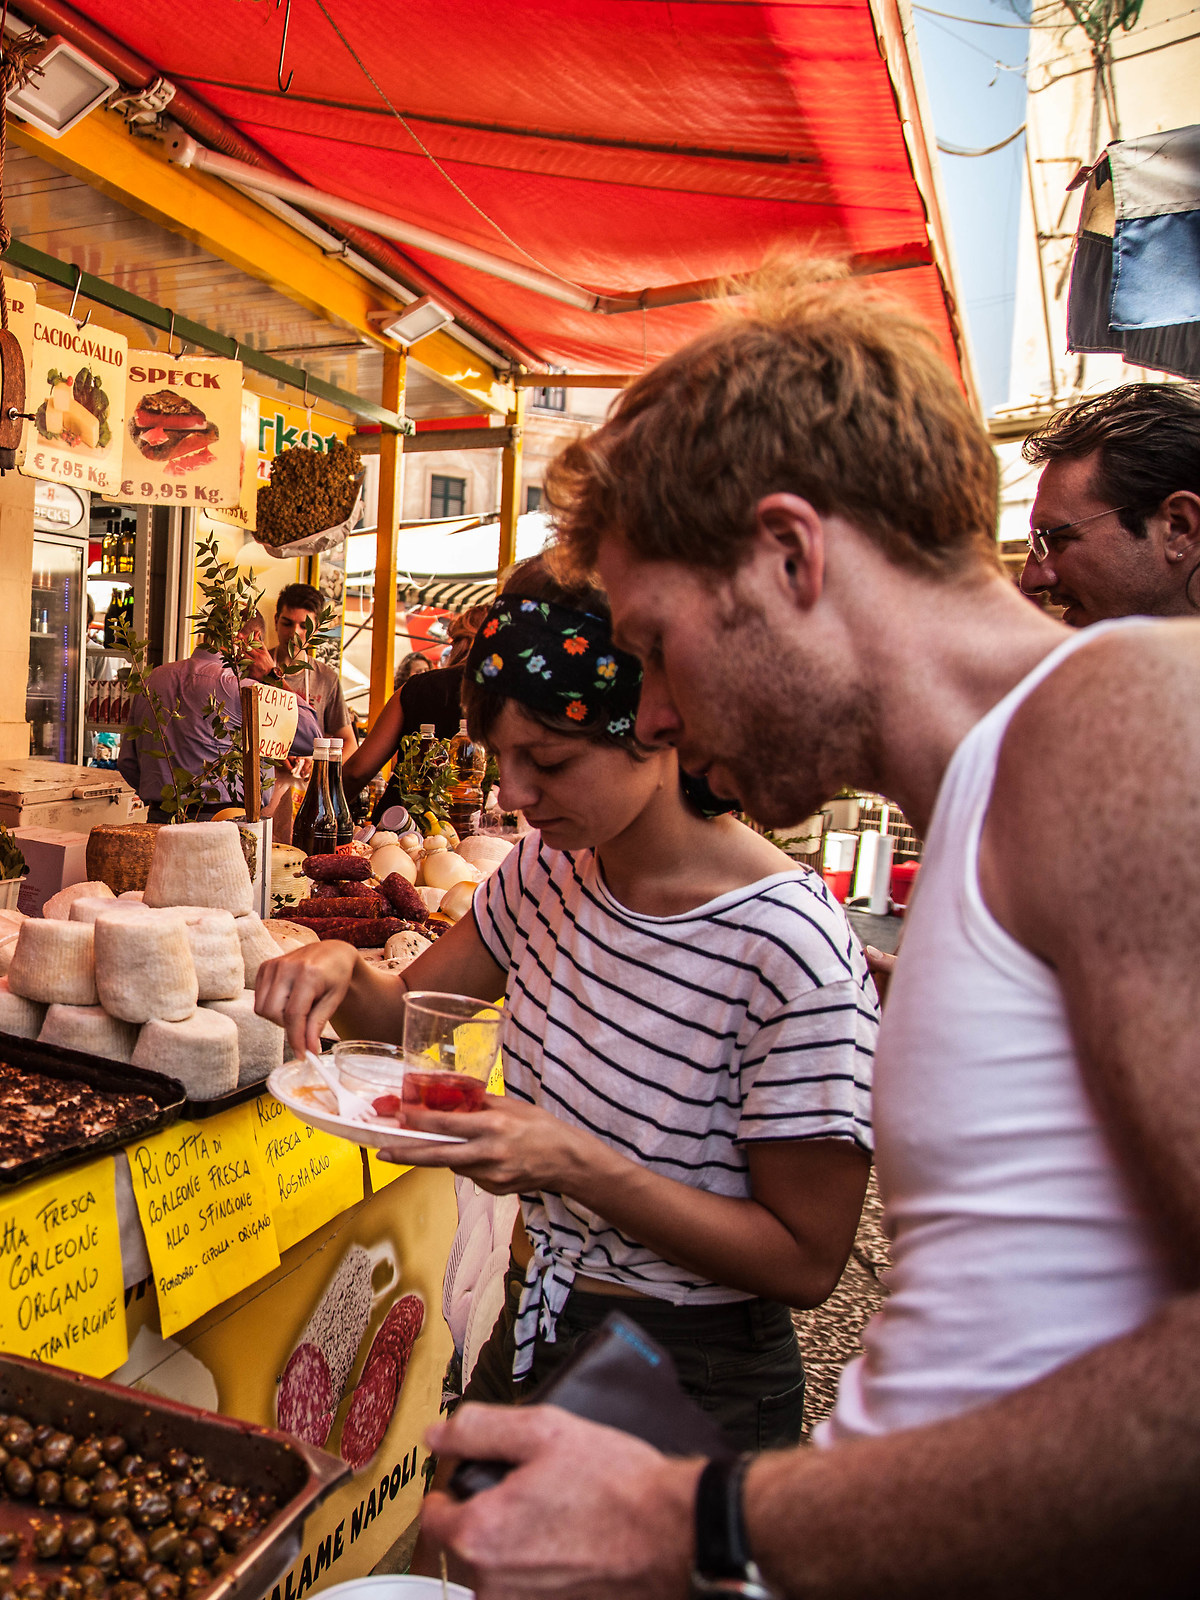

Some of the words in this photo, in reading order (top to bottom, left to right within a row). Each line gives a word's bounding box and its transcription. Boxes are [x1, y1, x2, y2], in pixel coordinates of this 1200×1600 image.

[33, 322, 123, 367] CACIOCAVALLO
[128, 365, 222, 391] SPECK
[33, 452, 46, 471] €
[50, 457, 84, 482] 7,95
[87, 465, 110, 488] Kg.
[121, 480, 134, 496] €
[141, 482, 188, 501] 9,95
[194, 485, 224, 504] Kg.
[258, 687, 294, 711] ALAME
[262, 712, 278, 727] DI
[265, 1130, 301, 1166] FRESCA
[207, 1159, 251, 1192] FRESCA
[36, 1191, 97, 1232] FRESCA
[166, 1226, 190, 1250] ALLO
[9, 1226, 99, 1290] CORLEONE
[264, 1518, 346, 1600] ALAME
[350, 1445, 419, 1544] NAPOLI
